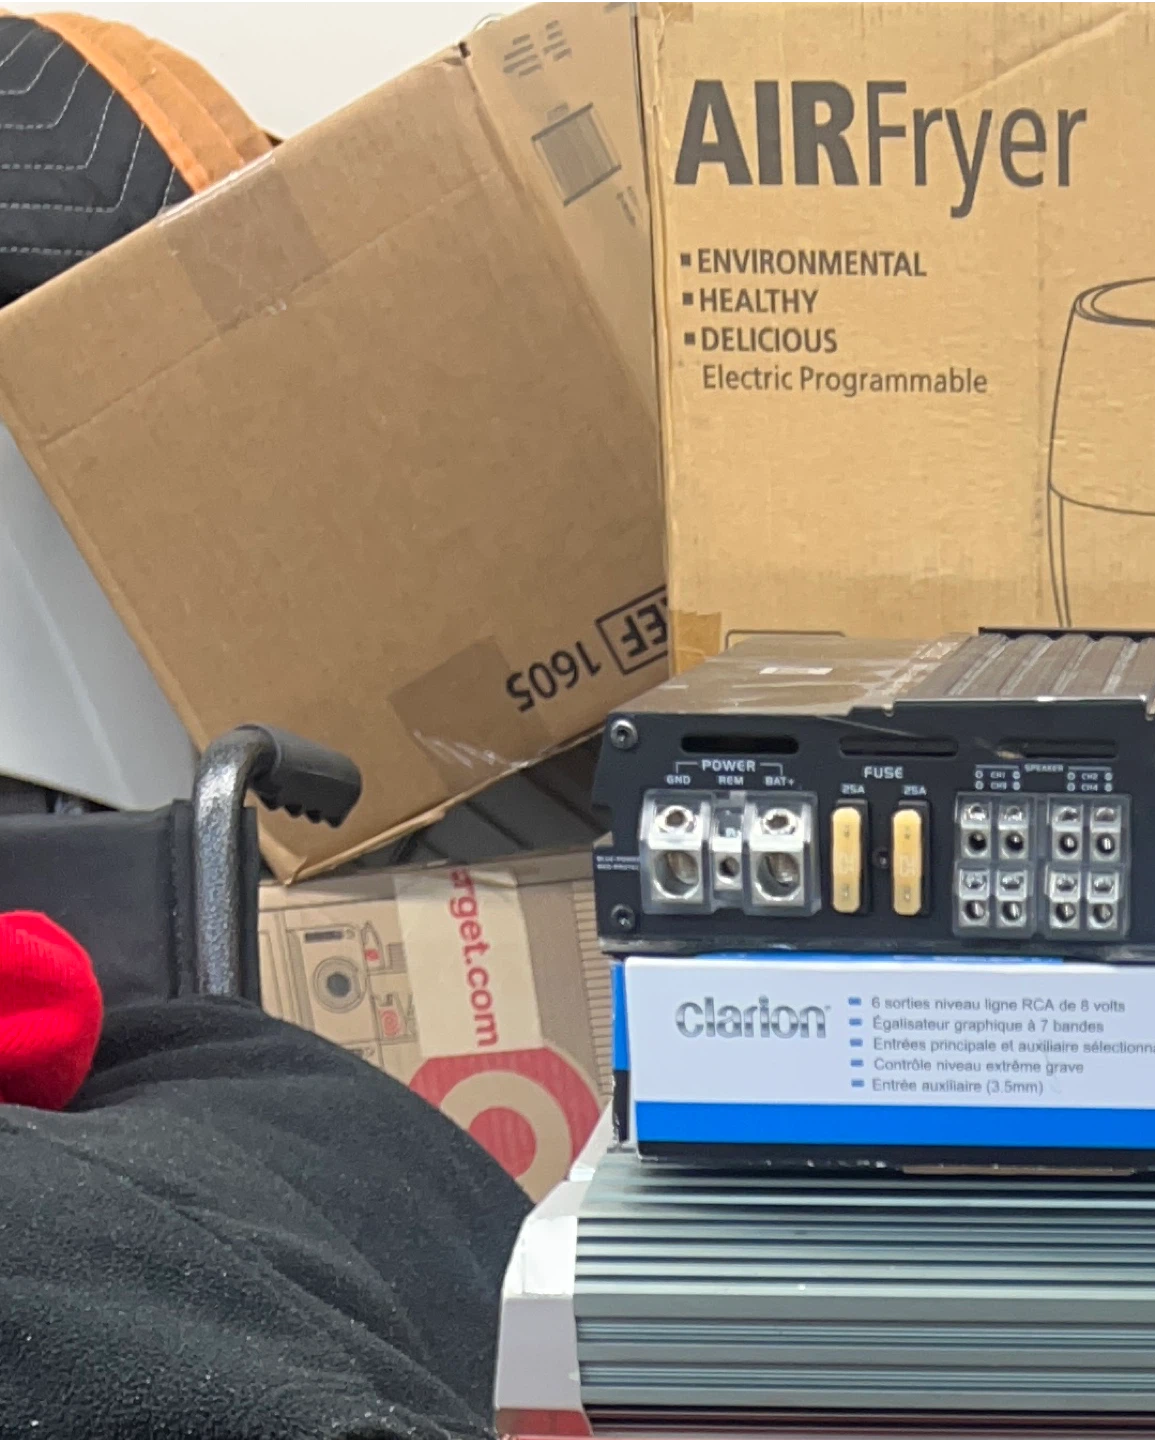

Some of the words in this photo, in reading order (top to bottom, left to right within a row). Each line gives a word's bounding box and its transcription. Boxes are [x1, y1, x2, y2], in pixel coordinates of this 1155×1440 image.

[674, 79, 1087, 219] AIRFryer
[697, 248, 928, 277] ENVIRONMENTAL
[699, 288, 819, 314] HEALTHY
[701, 326, 838, 353] DELICIOUS
[702, 364, 793, 391] Electric
[799, 366, 988, 398] Programmable
[505, 640, 602, 713] 1605
[702, 759, 756, 773] POWER
[863, 766, 904, 780] FUSE
[1024, 763, 1064, 773] SPEAKER
[666, 775, 691, 786] GND
[718, 775, 744, 786] REM
[764, 775, 795, 787] BAT+
[841, 783, 866, 796] 25A
[903, 784, 928, 797] 25A
[871, 997, 880, 1010] 6
[885, 997, 931, 1011] sorties
[934, 998, 981, 1012] niveau
[985, 999, 1018, 1014] ligne
[1022, 999, 1055, 1012] RCA
[1059, 1000, 1077, 1013] de
[1080, 1000, 1090, 1013] 8
[1094, 1000, 1126, 1014] volts
[675, 995, 827, 1039] clarion
[872, 1015, 950, 1034] Égalisateur
[954, 1018, 1024, 1035] graphique
[1040, 1019, 1049, 1033] 7
[1053, 1020, 1104, 1034] bandes
[873, 1036, 927, 1052] Entrées
[930, 1039, 997, 1055] principale
[1001, 1040, 1014, 1053] et
[1018, 1040, 1079, 1054] auxiliaire
[873, 1056, 932, 1072] Contrôle
[937, 1059, 982, 1073] niveau
[986, 1059, 1042, 1074] extrême
[1045, 1062, 1085, 1077] grave
[872, 1077, 917, 1092] Entrée
[921, 1079, 983, 1093] auxiliaire
[986, 1080, 1044, 1096] (3.5mm)
